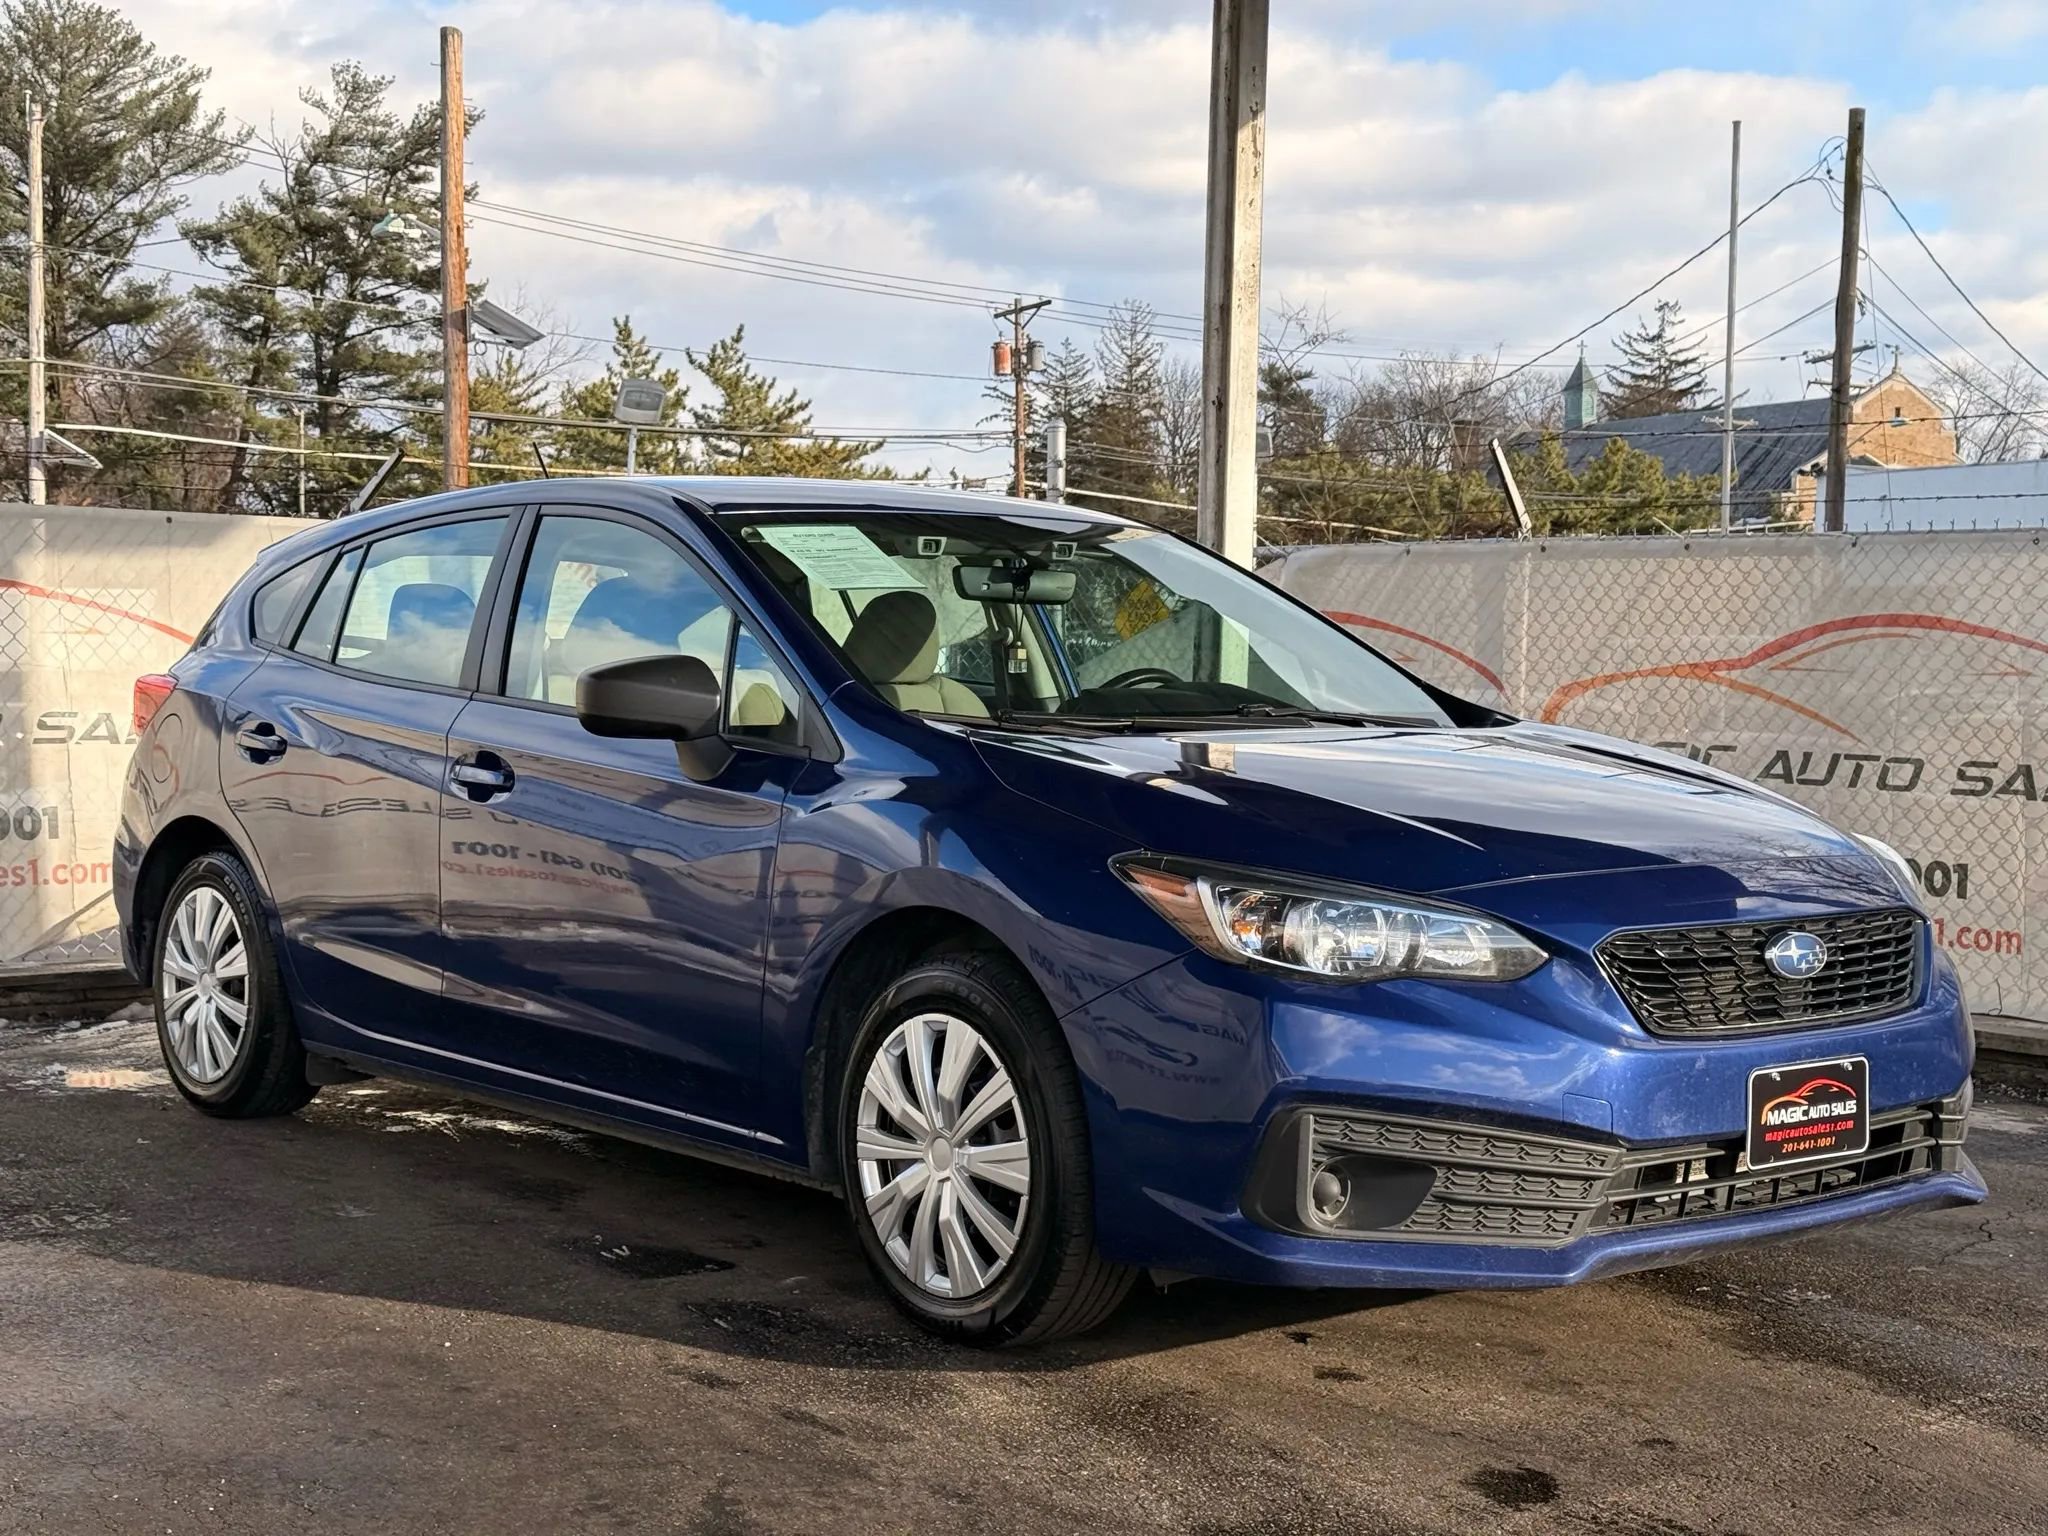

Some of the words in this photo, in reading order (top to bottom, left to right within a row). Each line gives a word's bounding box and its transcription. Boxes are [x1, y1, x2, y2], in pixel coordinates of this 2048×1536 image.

[32, 711, 138, 745] SA
[1753, 749, 1925, 792] AUTO
[1951, 760, 2048, 803] SA
[1766, 1105, 1809, 1126] MAGIC
[1809, 1105, 1830, 1119] AUTO
[1831, 1100, 1857, 1116] SALES
[1765, 1119, 1854, 1142] magicautosales1.com
[1782, 1136, 1836, 1153] 201-641-1001
